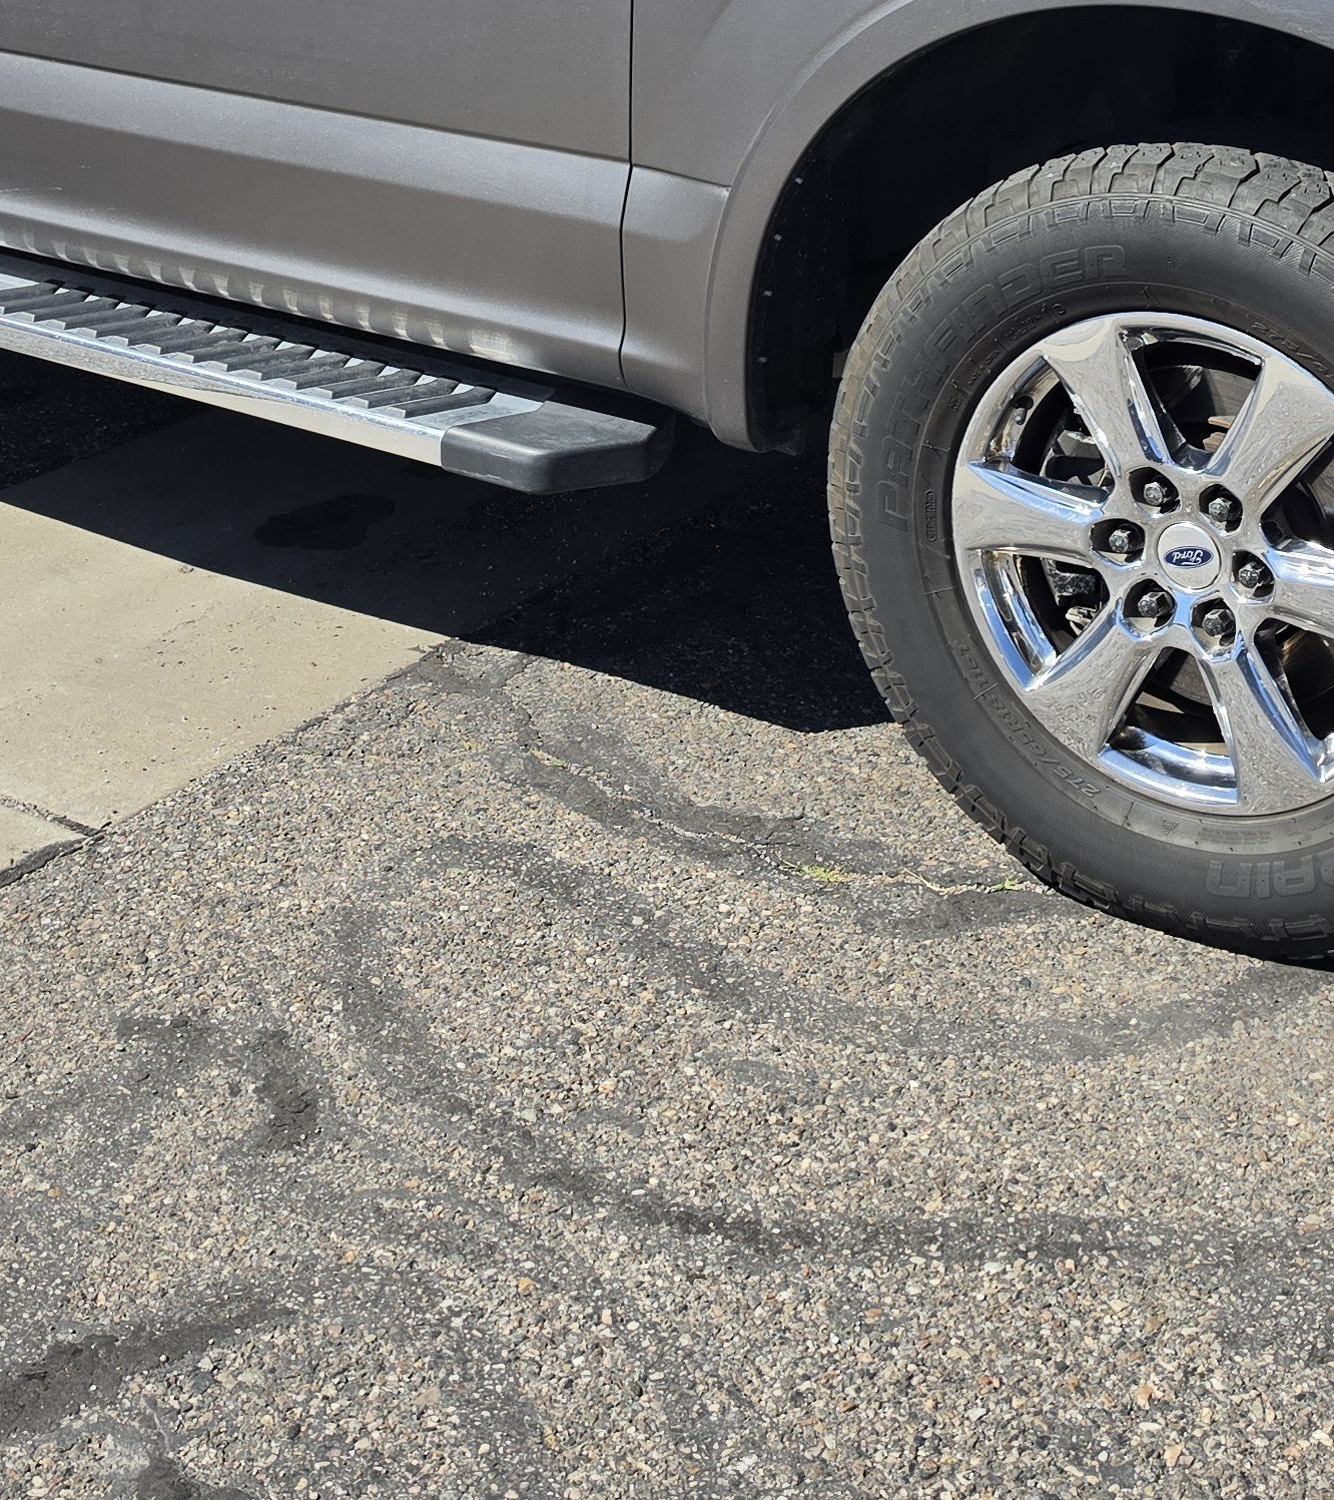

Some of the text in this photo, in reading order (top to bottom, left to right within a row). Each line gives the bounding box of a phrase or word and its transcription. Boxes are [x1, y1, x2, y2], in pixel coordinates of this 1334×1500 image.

[877, 244, 1128, 530] PATHFINDER
[1172, 550, 1203, 565] Ford
[988, 696, 1101, 798] 275/65R18
